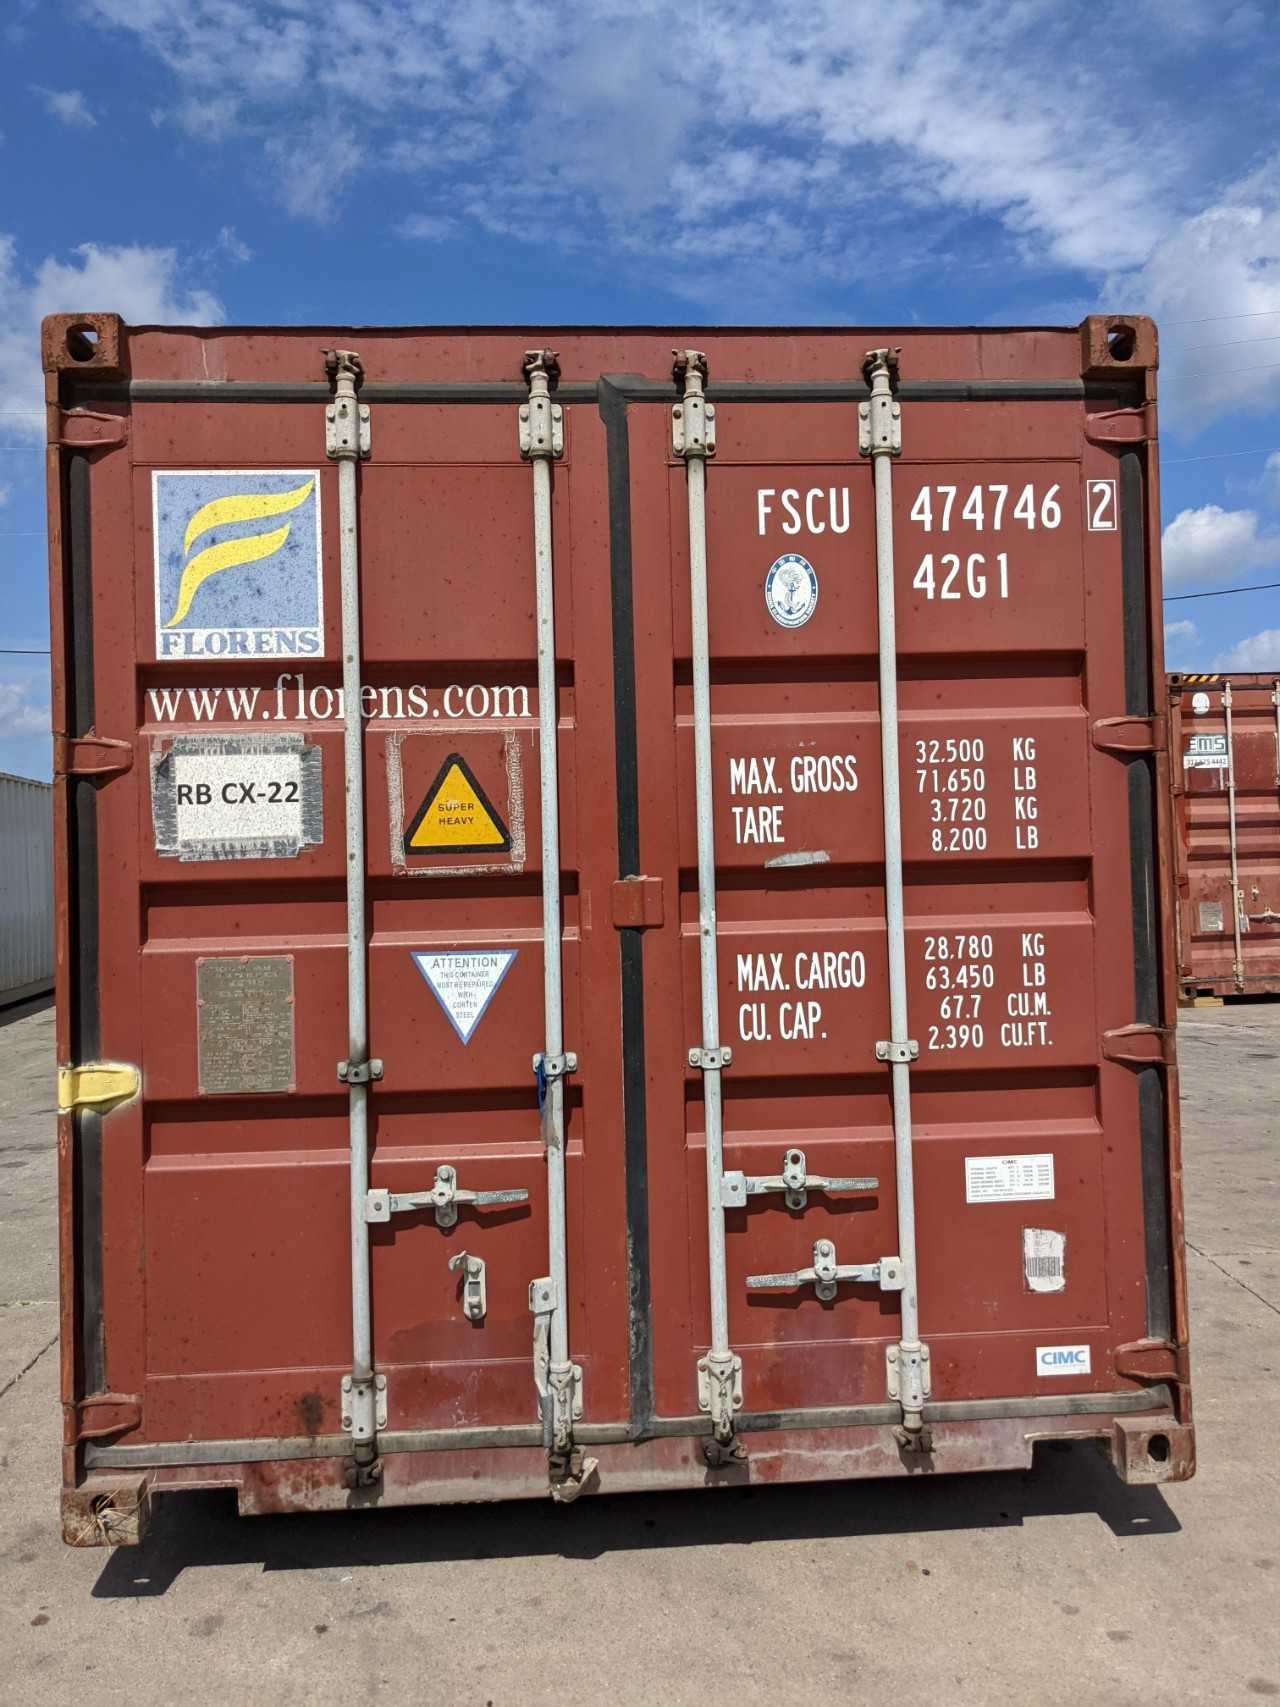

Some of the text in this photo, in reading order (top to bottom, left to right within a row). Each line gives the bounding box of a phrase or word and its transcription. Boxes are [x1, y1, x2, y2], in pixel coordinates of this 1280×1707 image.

[758, 483, 1112, 535] FSCU 474746 2
[913, 552, 1009, 600] 42G1
[160, 631, 320, 655] FLORENS
[146, 673, 532, 721] www.florens.com
[1013, 738, 1036, 761] KG
[731, 755, 858, 795] MAX. GROSS
[1014, 767, 1037, 790] LB
[177, 781, 300, 805] RB CX-22
[438, 803, 474, 811] SUPER
[1015, 797, 1038, 820] KG
[439, 817, 474, 825] HEAVY
[732, 806, 785, 844] TARE
[1016, 826, 1039, 850] LB
[1022, 933, 1045, 957] KG
[432, 957, 498, 969] ATTENTION
[737, 951, 866, 992] MAX. CARGO
[1023, 962, 1046, 987] LB
[940, 995, 981, 1019] 67.7
[740, 1002, 827, 1041] CU. CAP.
[1041, 1350, 1086, 1365] CIMC
